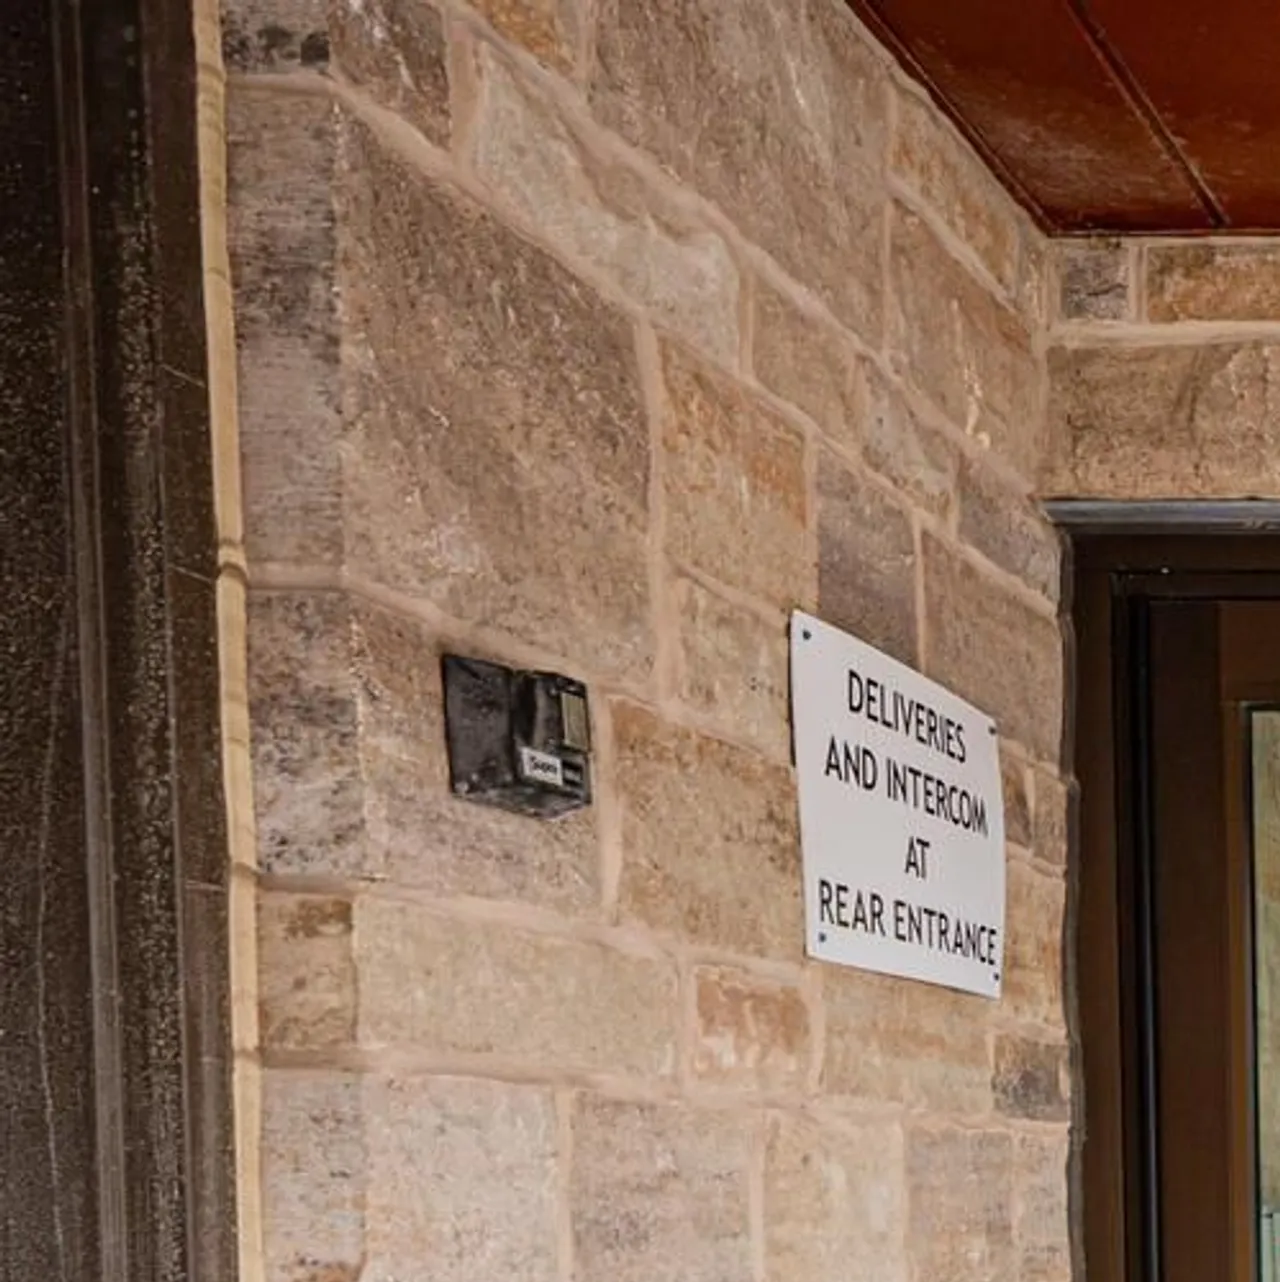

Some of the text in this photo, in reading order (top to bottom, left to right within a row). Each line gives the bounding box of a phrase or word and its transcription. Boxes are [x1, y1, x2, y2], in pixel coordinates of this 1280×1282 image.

[848, 669, 966, 763] DELIVERIES
[825, 735, 989, 837] AND INTERCOM
[904, 836, 931, 879] AT
[818, 879, 997, 966] REAR ENTRANCE
